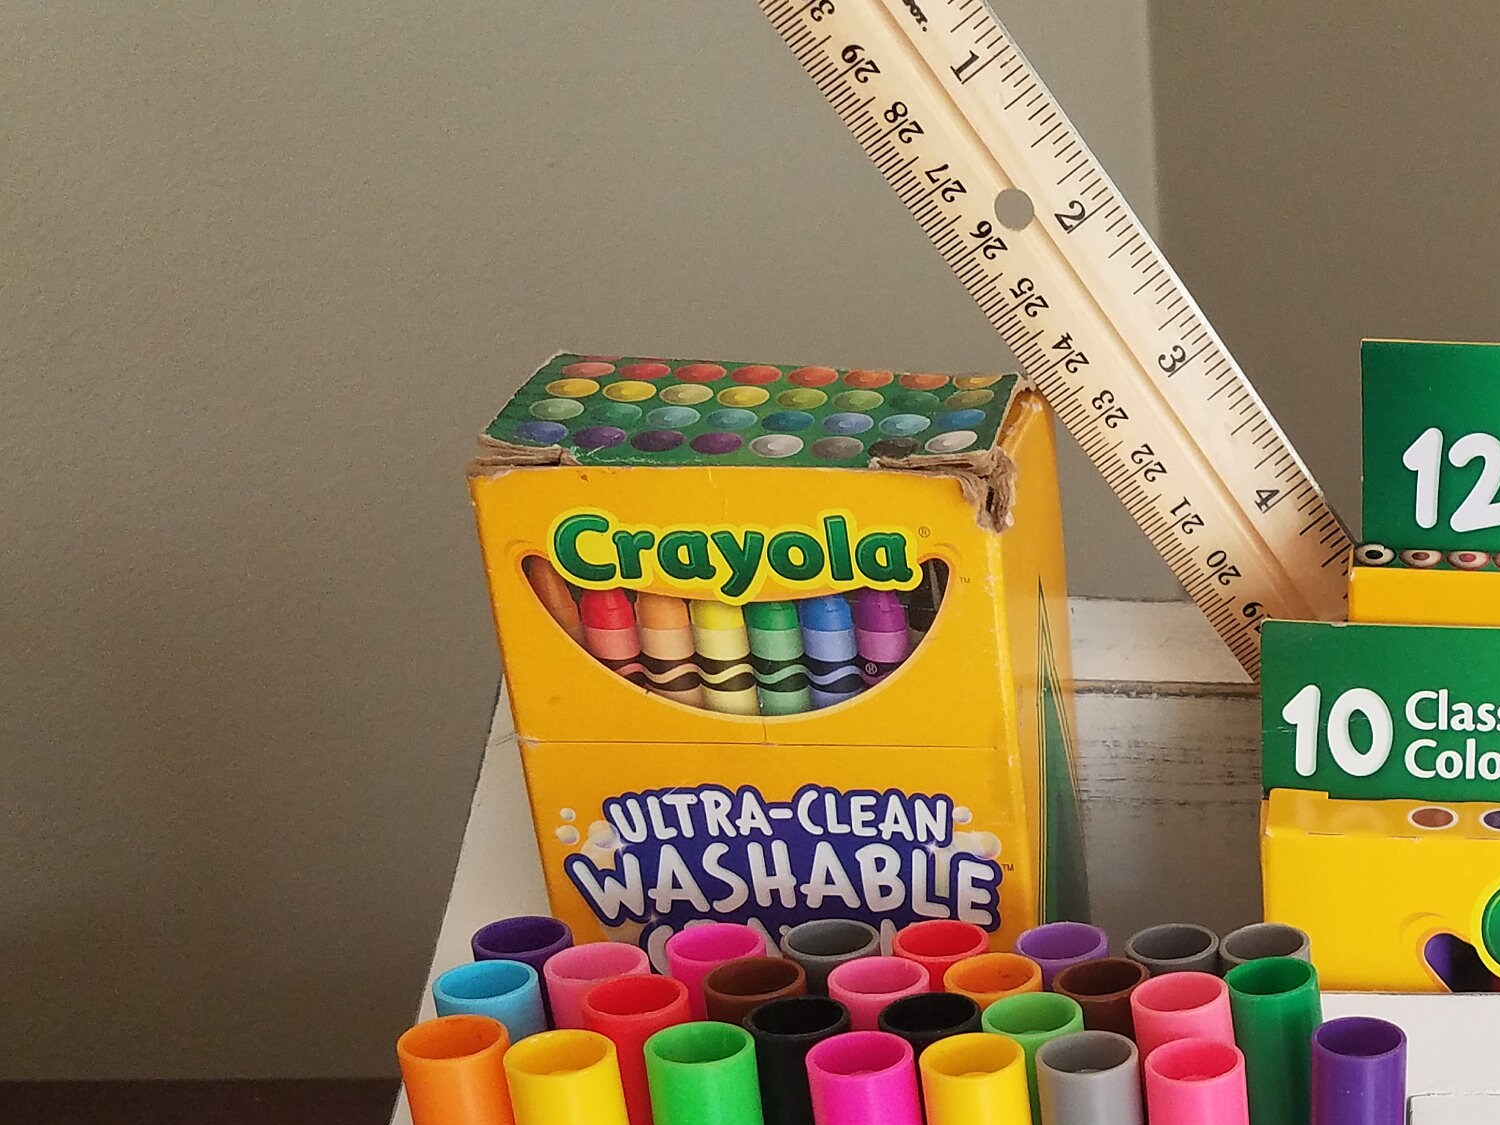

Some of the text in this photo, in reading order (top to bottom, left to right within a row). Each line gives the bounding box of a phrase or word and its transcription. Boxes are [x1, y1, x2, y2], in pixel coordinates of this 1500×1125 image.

[841, 44, 881, 84] 29
[884, 101, 924, 144] 28
[925, 163, 967, 204] 27
[969, 220, 1008, 261] 26
[1010, 277, 1049, 318] 25
[1051, 332, 1090, 374] 24
[1091, 389, 1129, 430] 23
[1130, 443, 1168, 483] 22
[1169, 496, 1205, 535] 21
[1206, 549, 1242, 587] 20
[950, 50, 1281, 514] 1 2 3 4
[553, 514, 914, 597] Crayola
[1282, 685, 1393, 778] 10
[609, 789, 948, 843] ULTRA-CLEAN
[573, 840, 997, 926] WASHABLE
